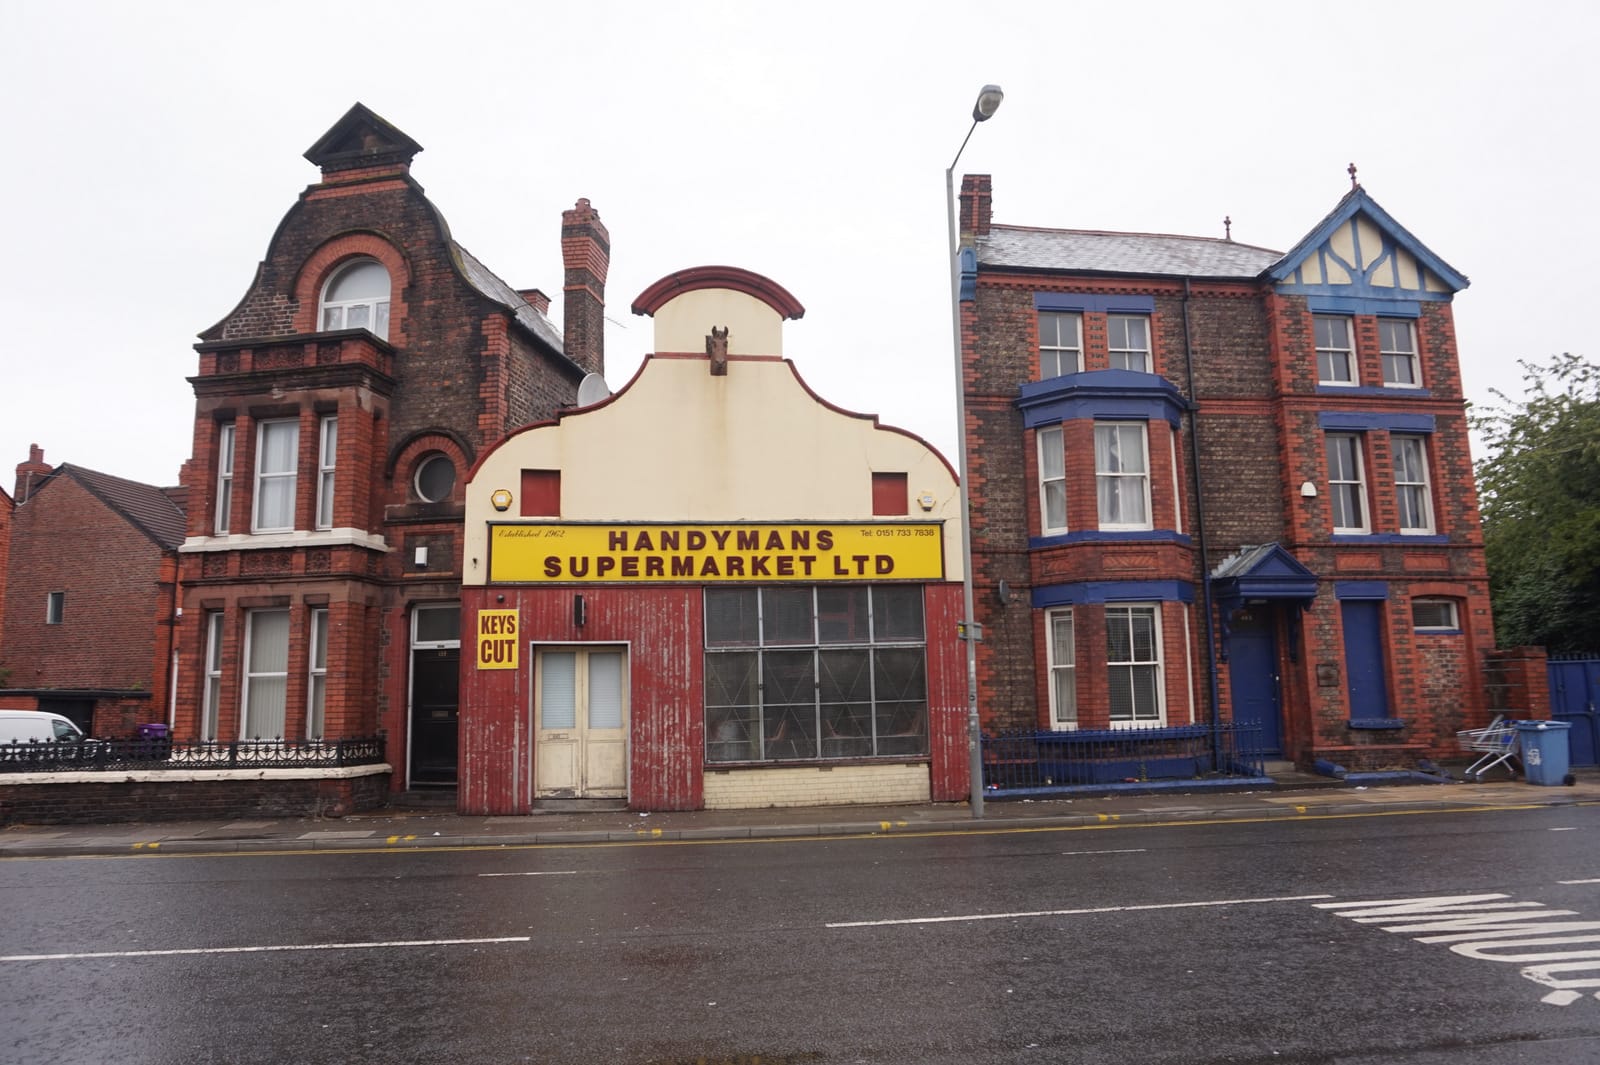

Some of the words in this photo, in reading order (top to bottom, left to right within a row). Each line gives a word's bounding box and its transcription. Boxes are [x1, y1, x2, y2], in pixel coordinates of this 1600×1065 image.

[498, 529, 542, 538] Established
[544, 528, 566, 538] 1962
[608, 529, 834, 551] HANDYMANS
[876, 529, 894, 537] 0151
[896, 529, 912, 537] 733
[543, 555, 817, 578] SUPERMARKET
[834, 555, 895, 575] LTD
[481, 615, 515, 635] KEYS
[480, 639, 515, 664] CUT
